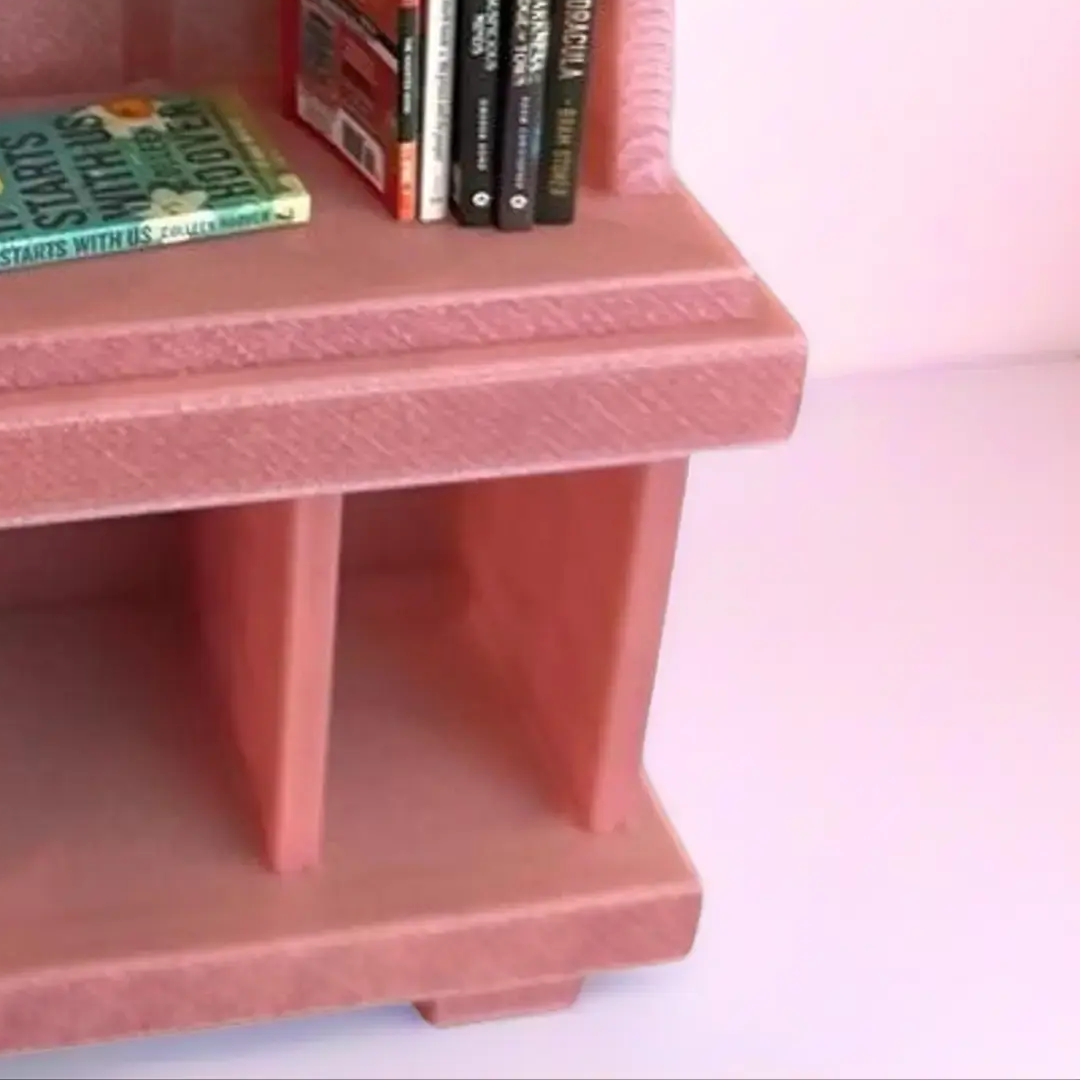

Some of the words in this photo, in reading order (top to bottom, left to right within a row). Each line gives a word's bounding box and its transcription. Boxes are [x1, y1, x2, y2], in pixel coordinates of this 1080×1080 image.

[54, 114, 112, 148] US
[72, 150, 153, 222] WITH
[0, 239, 67, 267] STARTS
[72, 230, 123, 254] WITH
[127, 225, 153, 247] US
